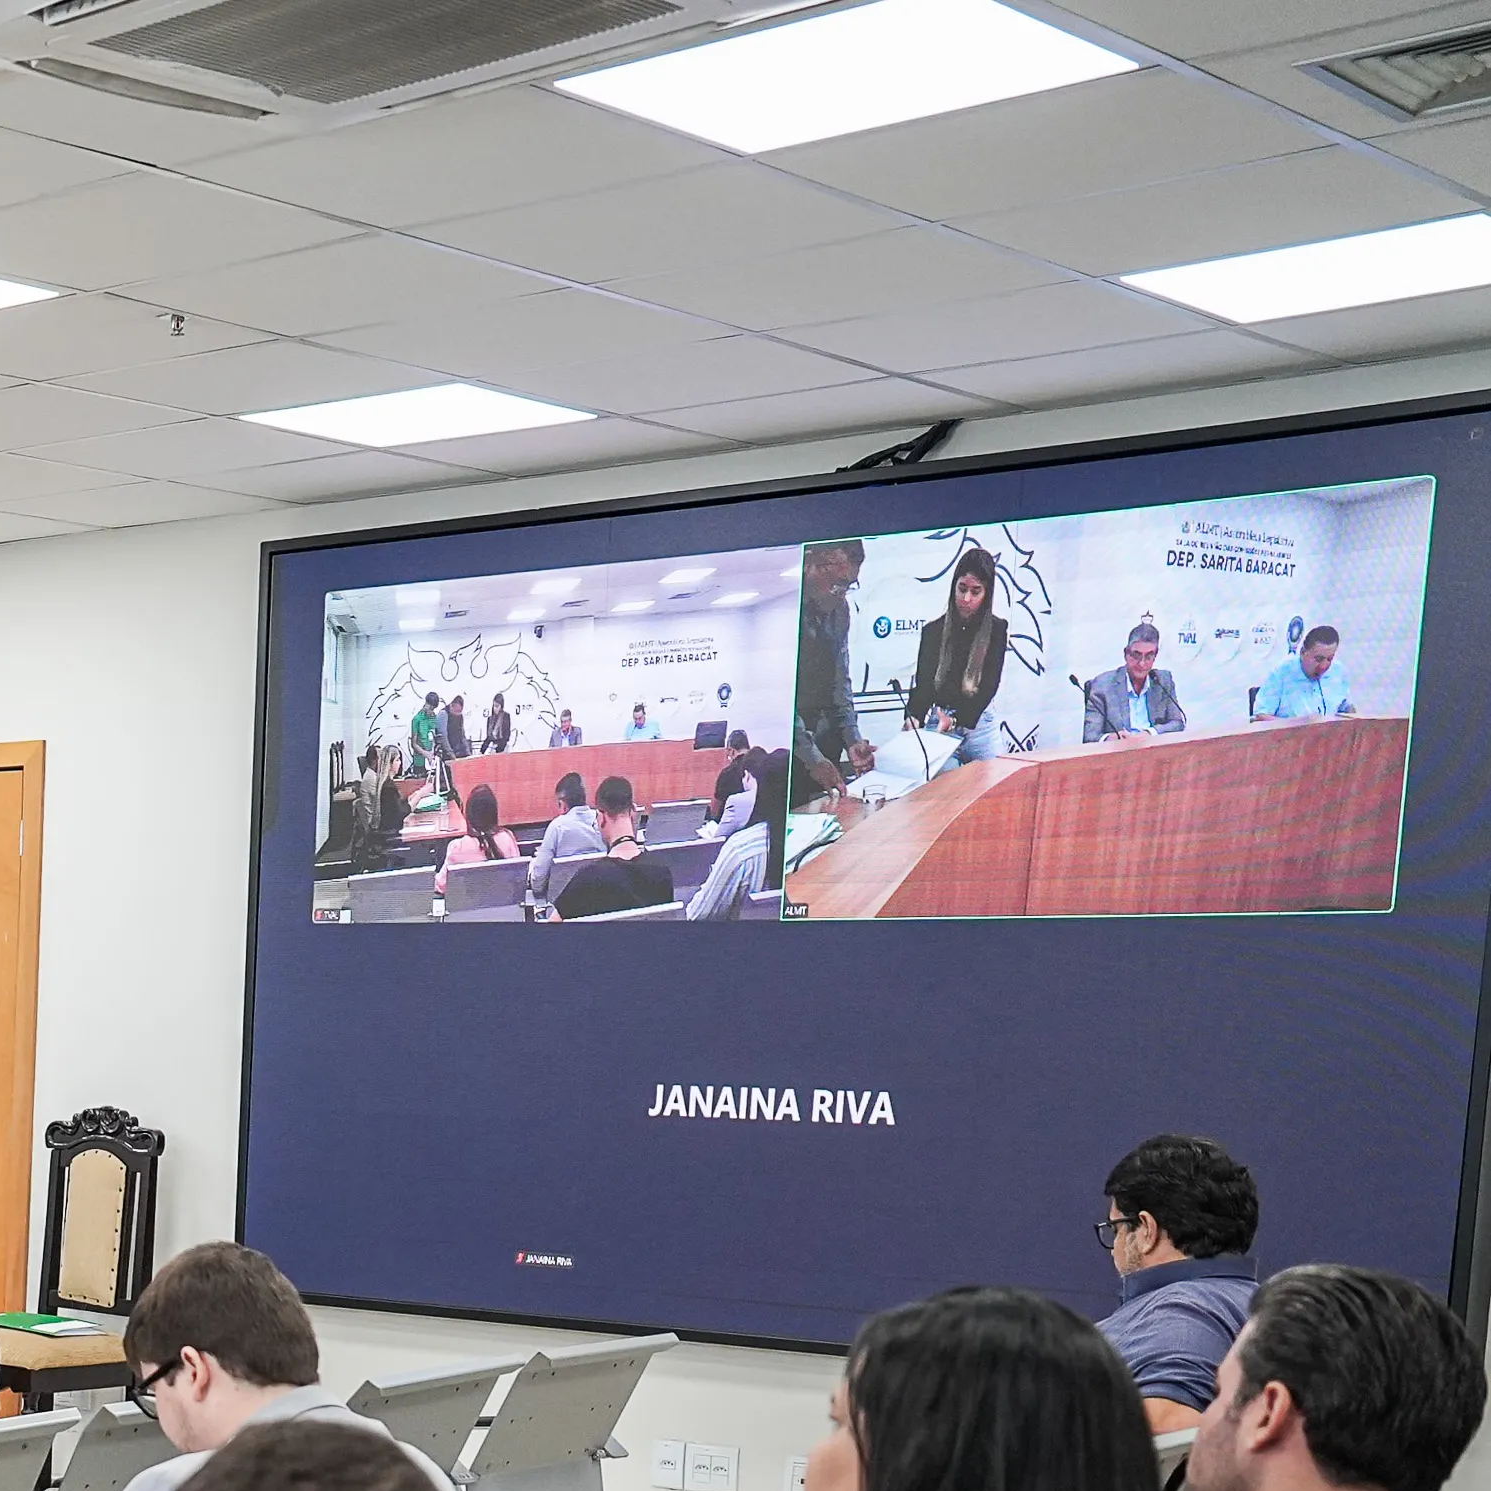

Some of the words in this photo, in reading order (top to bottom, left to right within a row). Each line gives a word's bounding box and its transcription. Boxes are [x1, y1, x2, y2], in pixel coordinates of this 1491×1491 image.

[1167, 550, 1196, 569] DEP.
[1200, 553, 1243, 573] SARITA
[1245, 559, 1296, 578] BARACAT
[643, 654, 674, 666] SARITA
[677, 651, 718, 663] BARACAT
[785, 906, 807, 916] ALMT
[648, 1083, 801, 1122] JANAINA
[811, 1089, 896, 1126] RIVA
